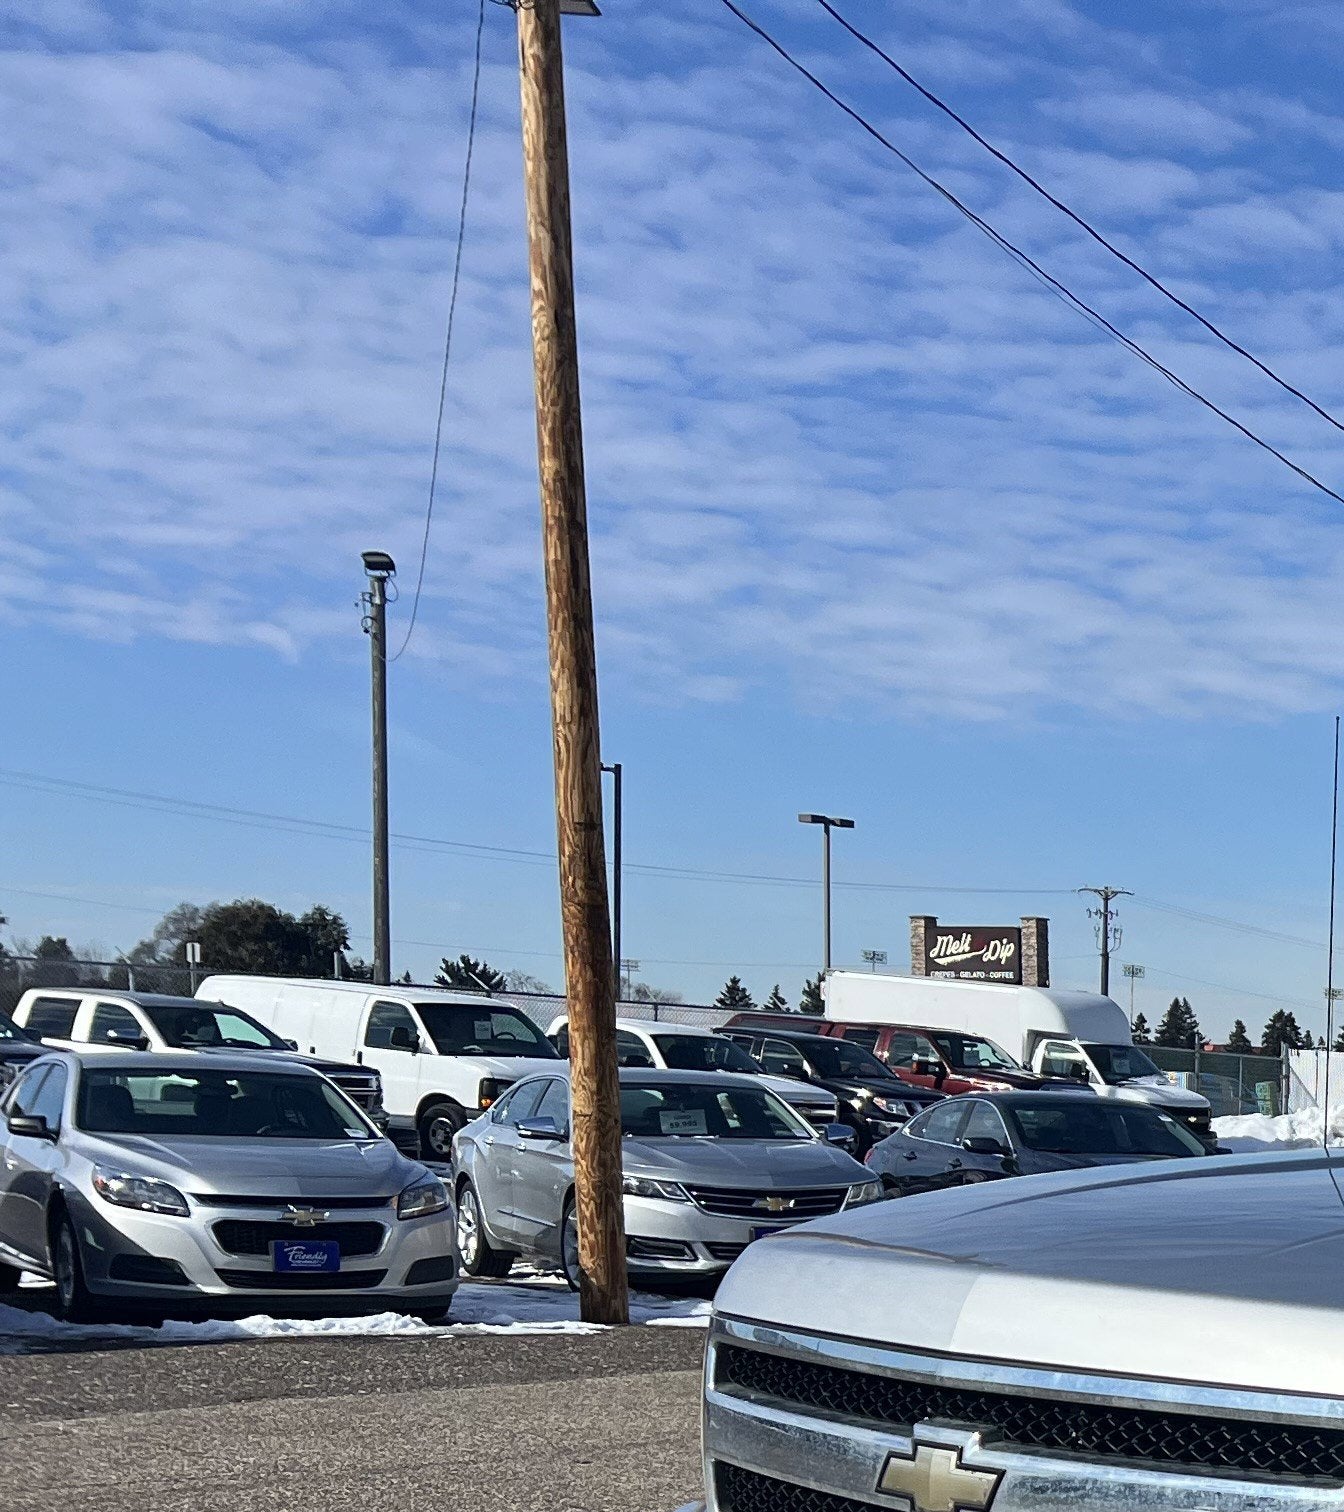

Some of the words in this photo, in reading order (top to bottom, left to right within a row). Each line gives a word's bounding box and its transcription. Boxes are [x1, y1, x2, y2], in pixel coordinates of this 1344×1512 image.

[929, 932, 972, 958] Melt
[982, 938, 1015, 965] Dip
[989, 971, 1015, 979] COFFEE
[283, 1246, 328, 1264] Friendly
